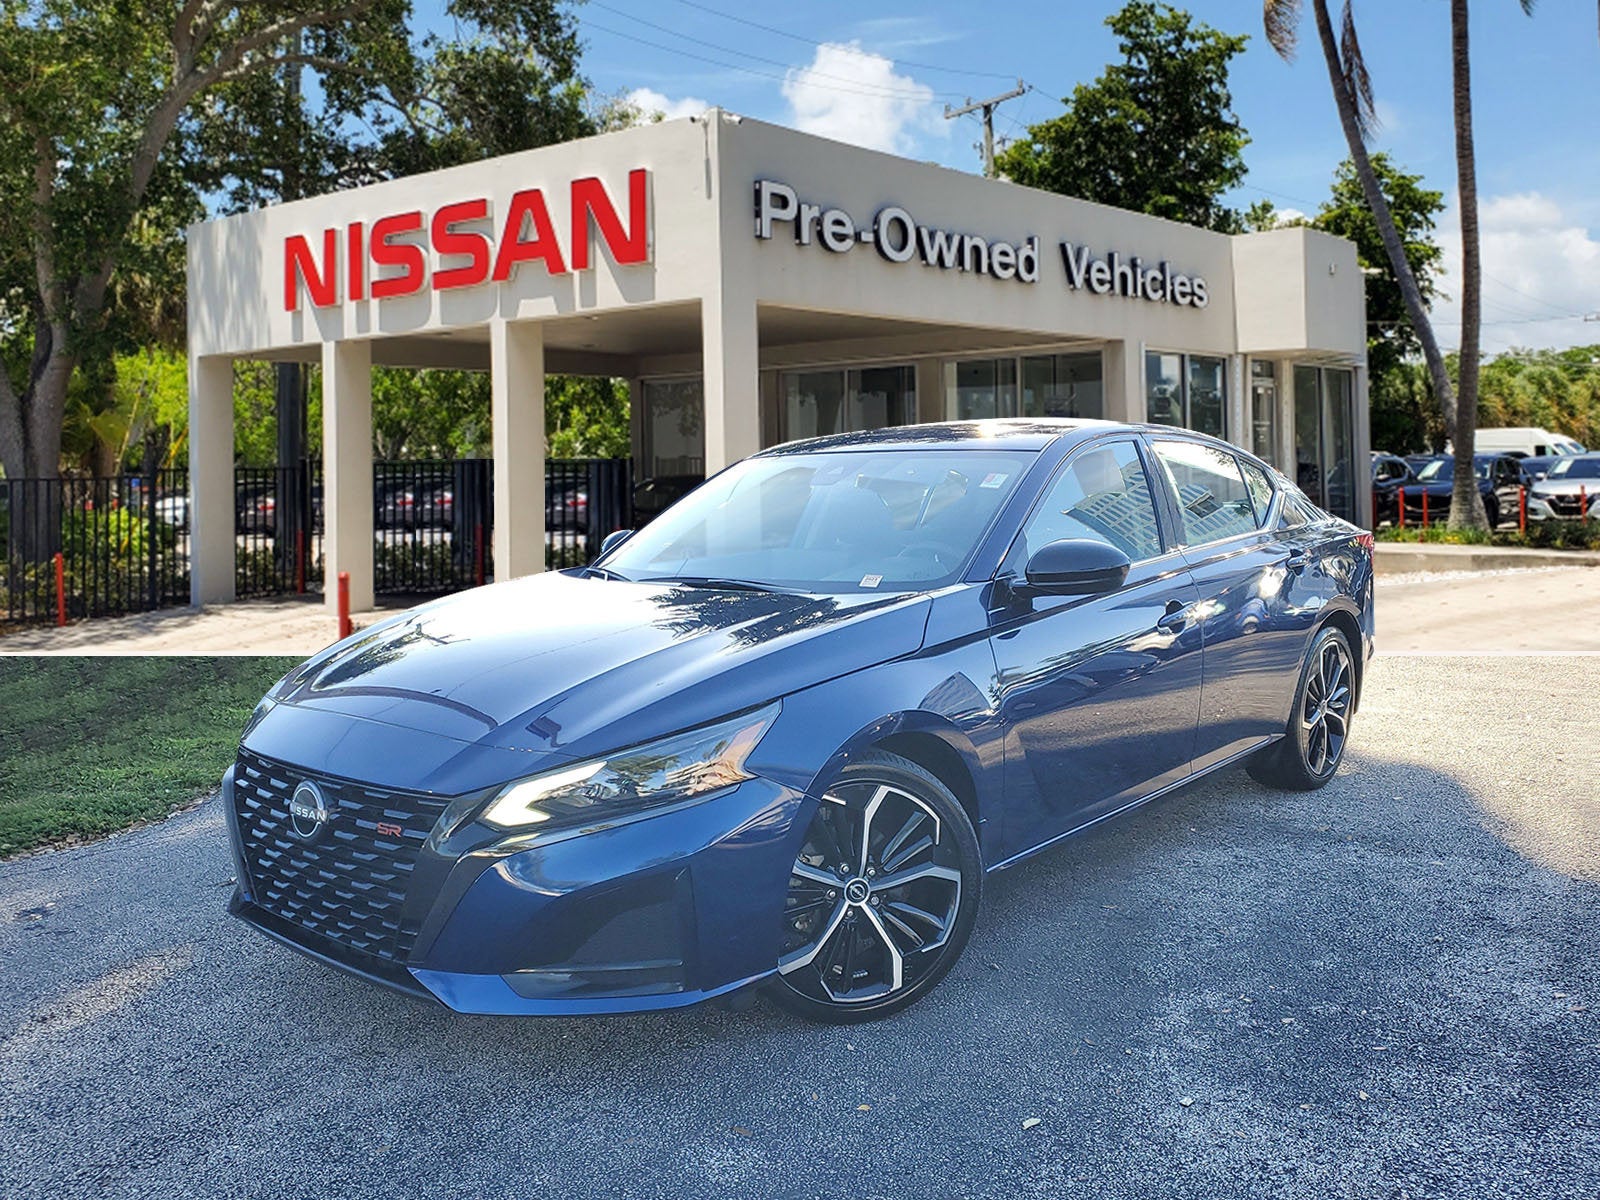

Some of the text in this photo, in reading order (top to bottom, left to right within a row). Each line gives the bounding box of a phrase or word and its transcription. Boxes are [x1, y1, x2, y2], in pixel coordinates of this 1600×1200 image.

[284, 168, 649, 312] NISSAN
[755, 179, 1209, 308] Pre-Owned Vehicles
[377, 822, 402, 837] SR
